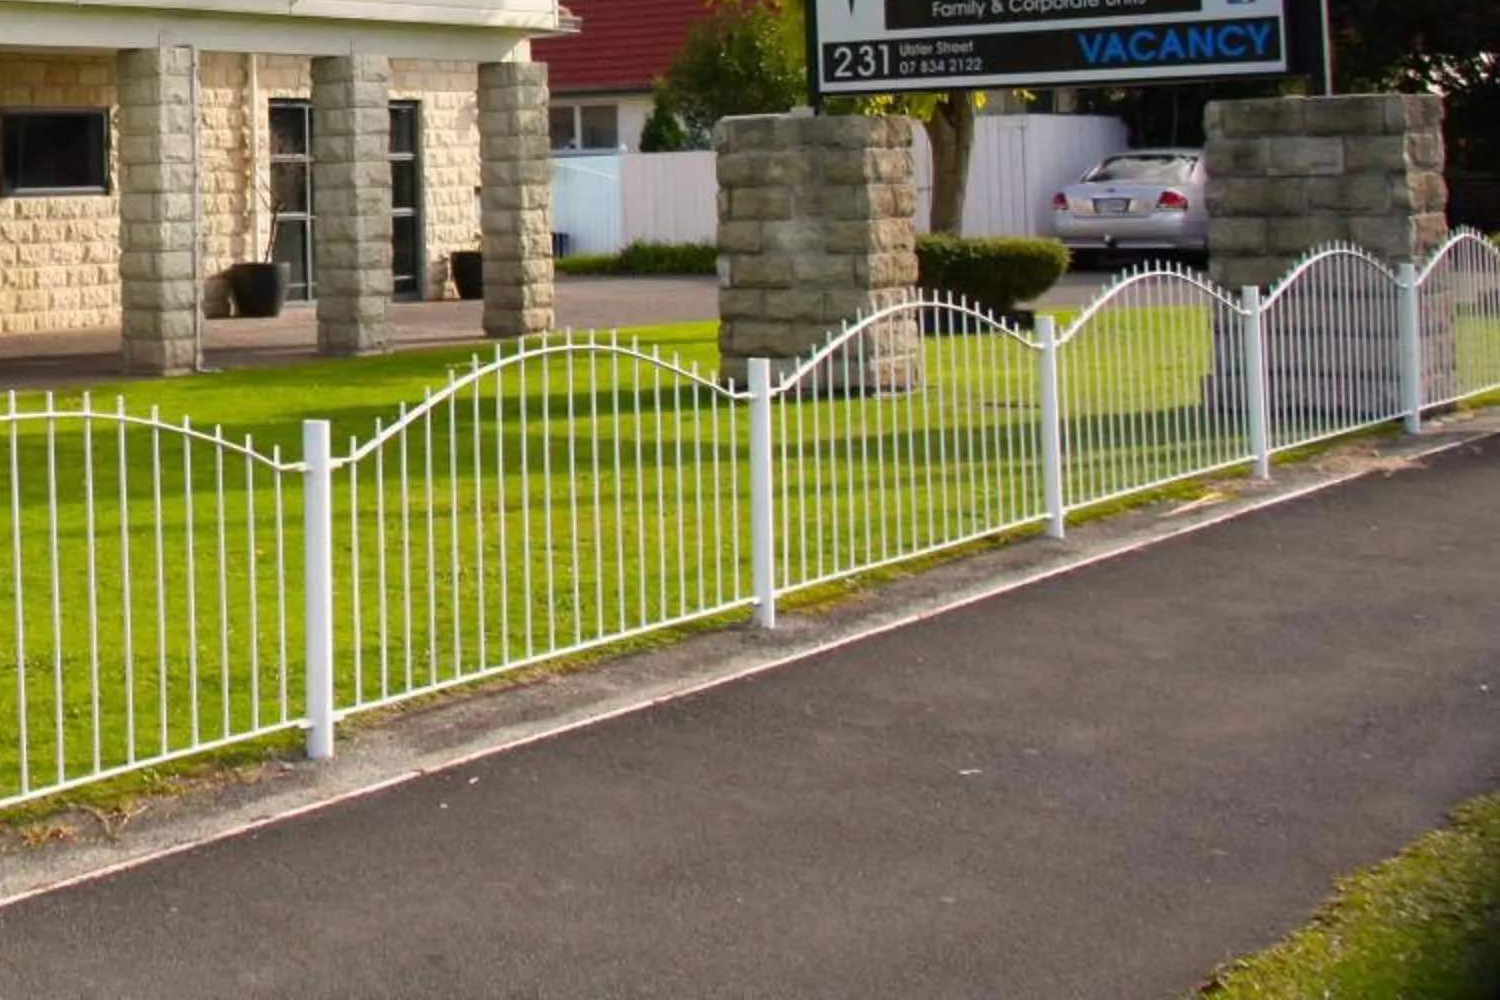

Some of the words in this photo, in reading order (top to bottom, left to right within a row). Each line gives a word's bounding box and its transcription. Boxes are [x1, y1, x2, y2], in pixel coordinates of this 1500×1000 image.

[932, 0, 985, 18] Family
[899, 42, 933, 57] Ulster
[935, 40, 974, 55] Street
[1077, 23, 1272, 63] VACANCY
[834, 44, 890, 77] 231
[899, 61, 916, 75] 07
[920, 59, 945, 74] 834
[949, 57, 984, 73] 2122
